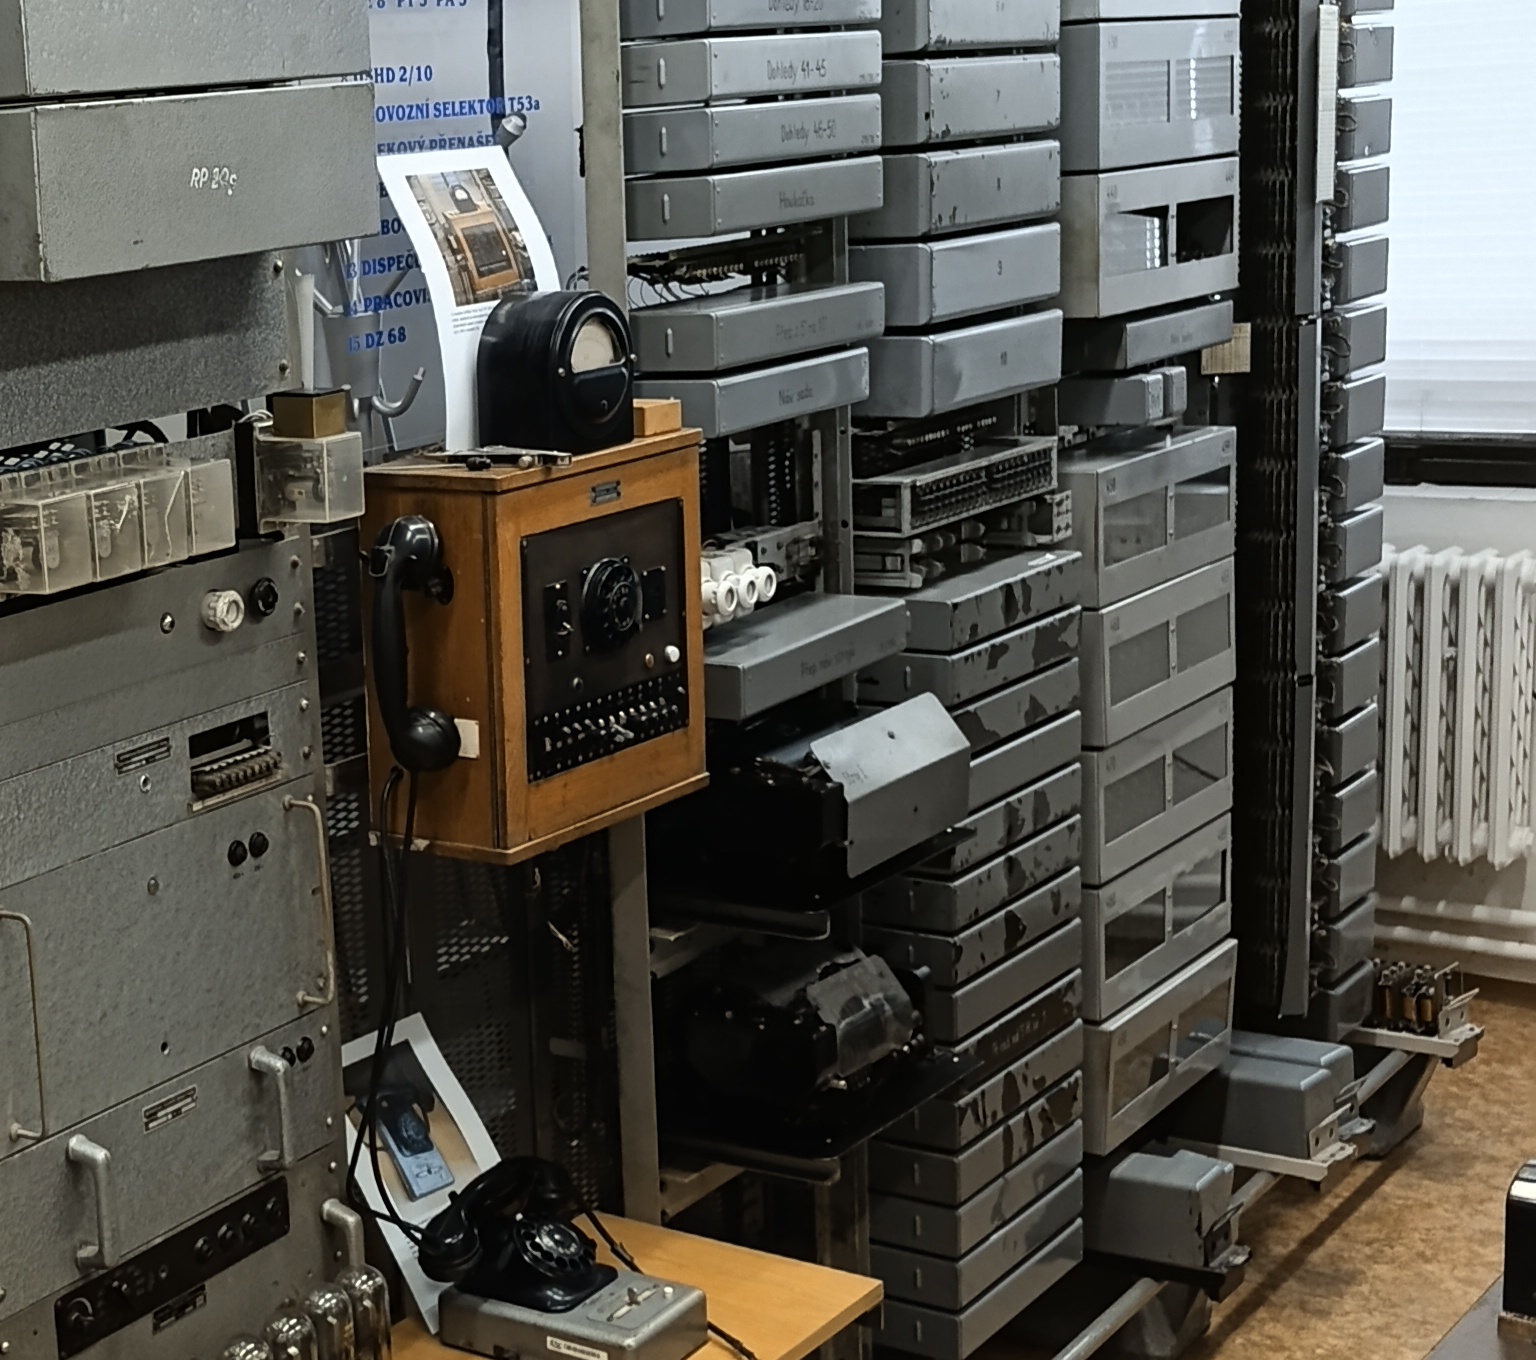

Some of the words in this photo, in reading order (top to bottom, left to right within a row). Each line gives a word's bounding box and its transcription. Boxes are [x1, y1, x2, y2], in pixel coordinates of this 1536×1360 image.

[398, 65, 433, 86] 2/10
[433, 98, 505, 120] SELEKTOR
[507, 95, 541, 114] T53a
[189, 167, 209, 190] RP
[364, 288, 431, 314] PRACOVI
[364, 329, 387, 350] DZ
[387, 325, 407, 345] 68
